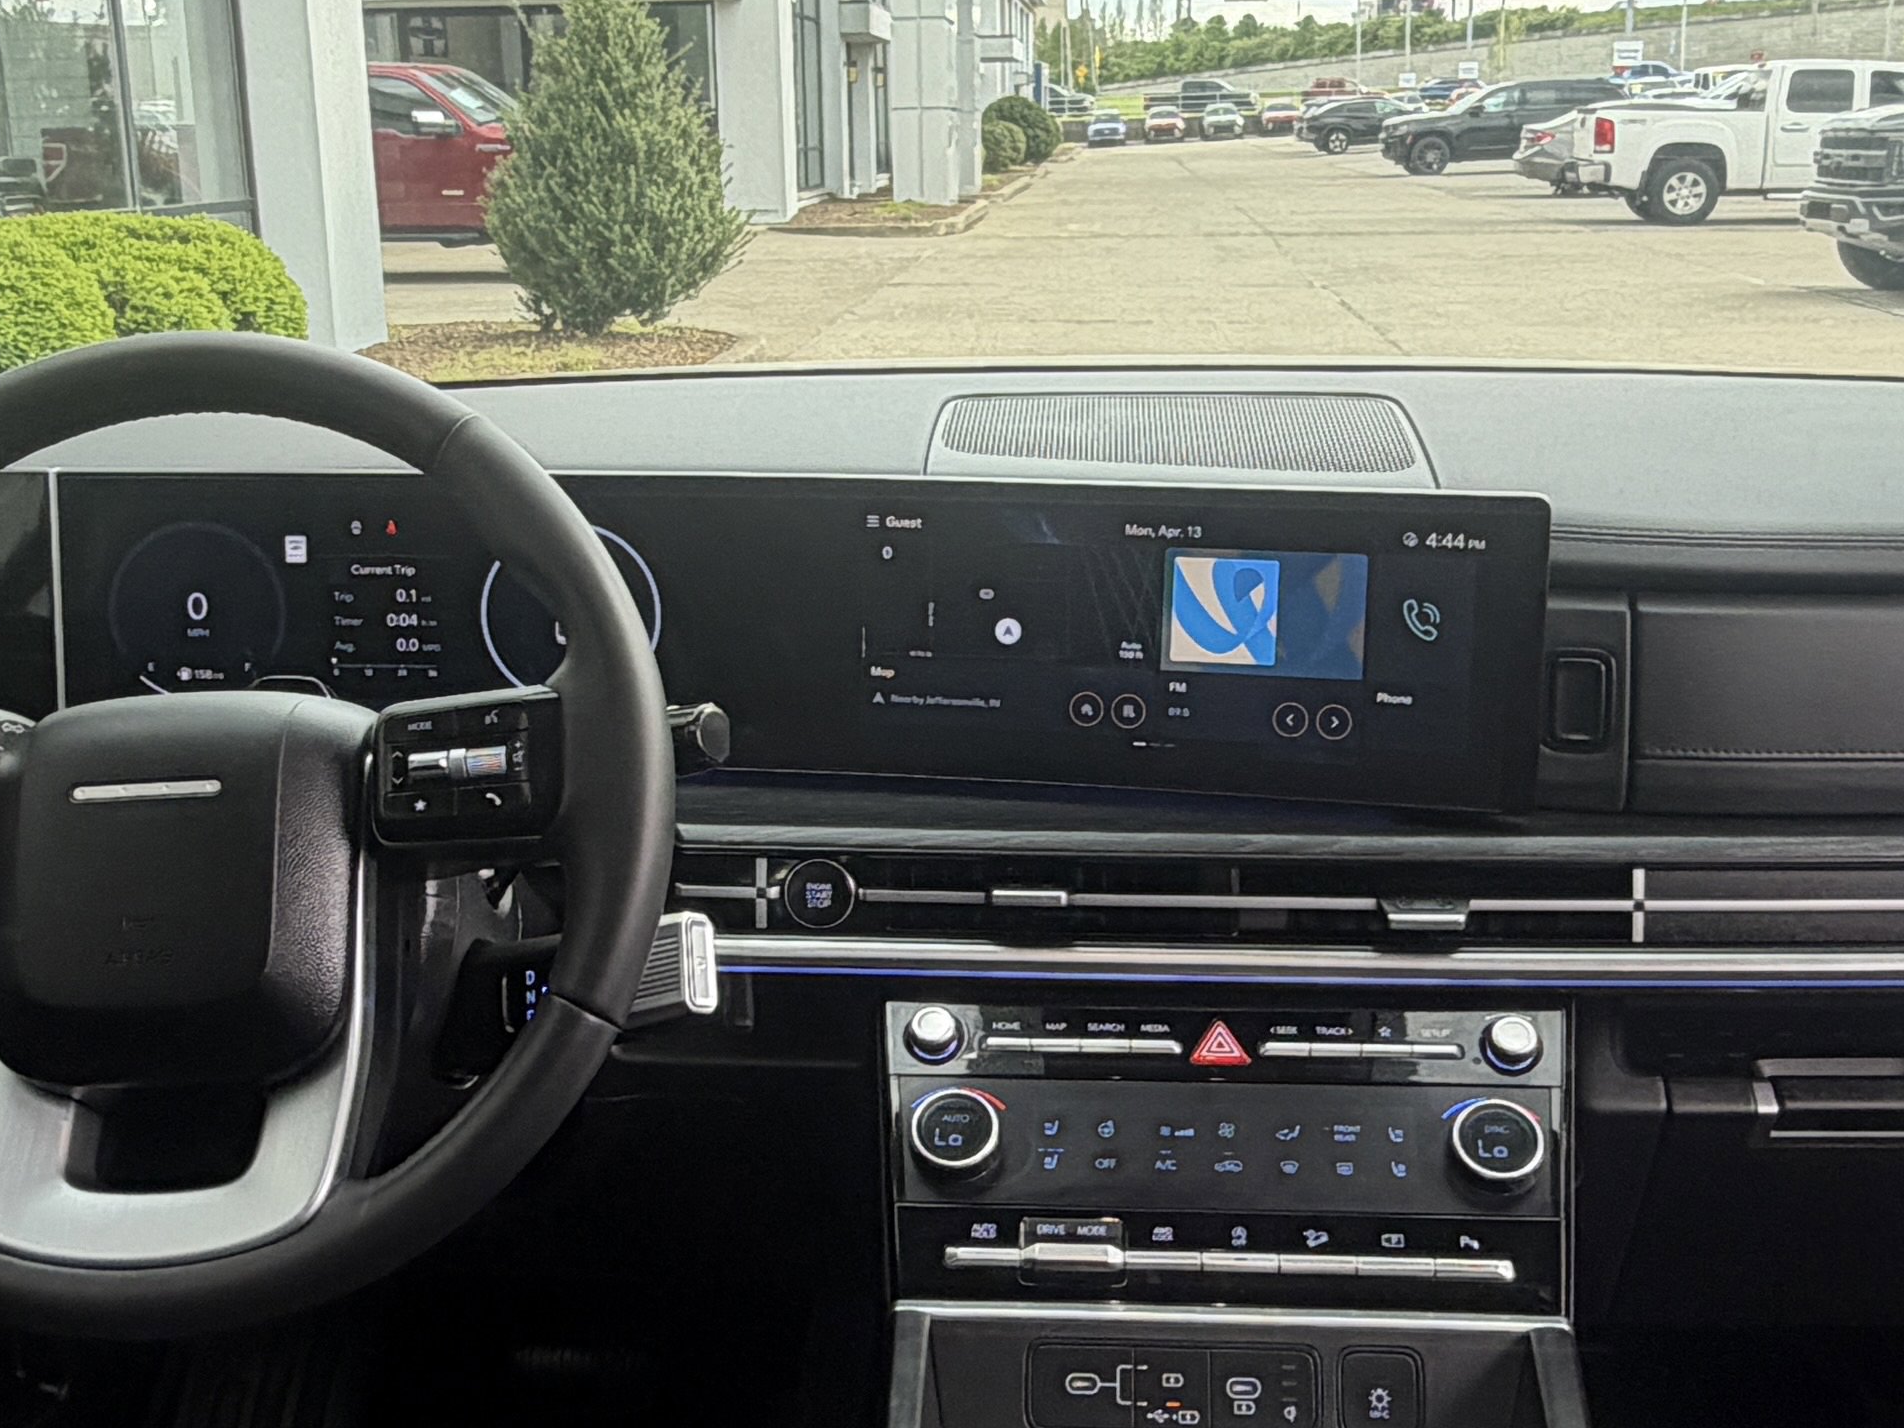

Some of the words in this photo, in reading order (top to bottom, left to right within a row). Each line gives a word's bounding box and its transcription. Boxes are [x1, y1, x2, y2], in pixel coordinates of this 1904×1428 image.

[886, 516, 922, 529] Guest
[1125, 524, 1156, 539] Mon,
[1158, 525, 1184, 540] Apr.
[1187, 525, 1202, 538] 13
[1425, 532, 1465, 548] 4:44
[351, 564, 392, 576] Current
[393, 564, 416, 578] Trip
[334, 591, 354, 603] Trip
[396, 589, 417, 603] 0.1
[187, 592, 209, 620] 0
[334, 616, 364, 627] Timer
[396, 638, 419, 652] 0.0
[1169, 681, 1187, 693] FM
[1377, 692, 1413, 705] Phone
[525, 970, 536, 985] D
[526, 989, 536, 1005] N
[1046, 1022, 1067, 1031] MAP
[1087, 1022, 1125, 1032] SEARCH
[942, 1114, 970, 1123] AUTO
[1095, 1158, 1117, 1169] OFF
[1155, 1159, 1177, 1171] A/C
[1036, 1224, 1066, 1236] DRIVE
[1077, 1225, 1108, 1237] MODE
